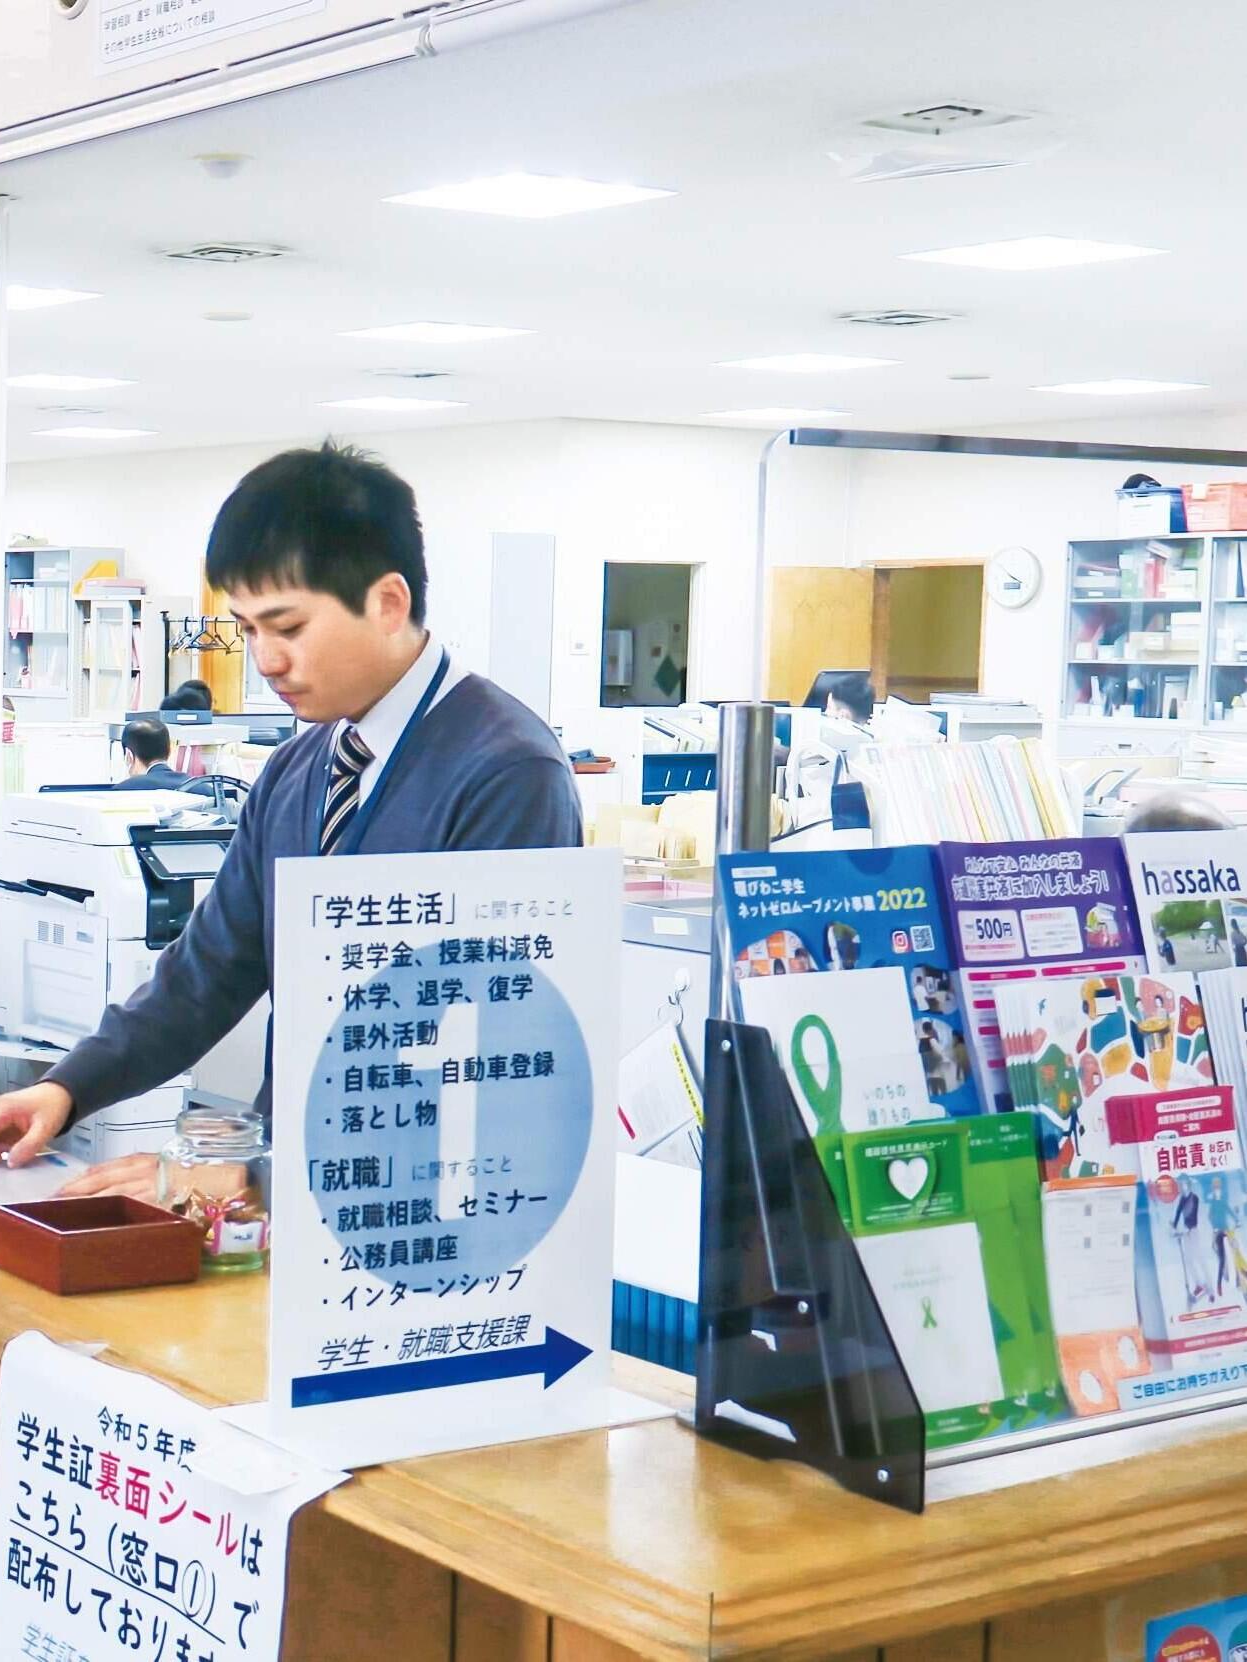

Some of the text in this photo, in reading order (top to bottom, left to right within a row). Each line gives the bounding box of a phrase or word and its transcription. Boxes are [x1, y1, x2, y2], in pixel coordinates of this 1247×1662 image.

[1141, 859, 1241, 896] hassaka
[310, 892, 574, 928] 「学生生活」 に関すること
[877, 887, 927, 911] 2022
[975, 917, 1013, 940] 500円
[306, 1156, 513, 1193] 「就職」 に関すること
[1157, 1143, 1205, 1172] 自賠責
[316, 1314, 532, 1371] 学生・就職支援課
